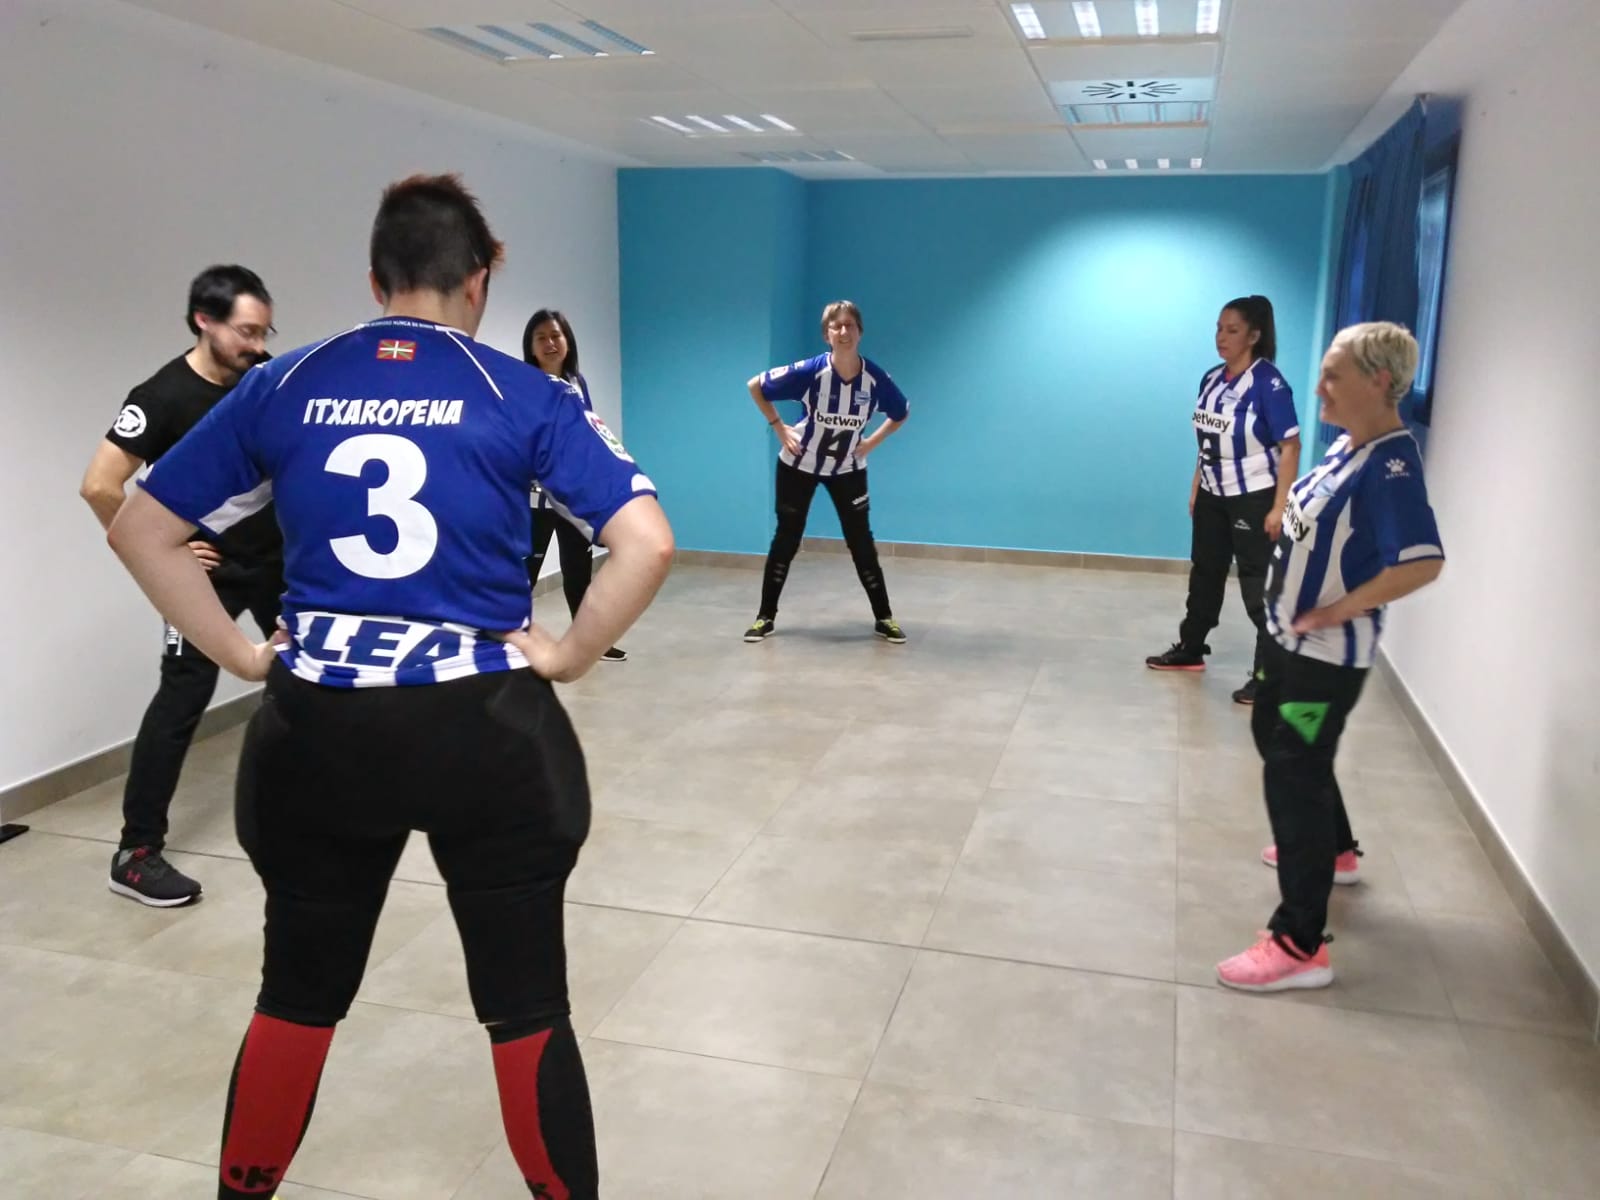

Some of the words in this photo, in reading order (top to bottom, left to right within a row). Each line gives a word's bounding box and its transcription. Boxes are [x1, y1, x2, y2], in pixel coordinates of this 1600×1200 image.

[303, 399, 463, 427] ITXAROPENA
[816, 411, 864, 430] betway
[324, 434, 438, 580] 3
[302, 615, 461, 669] LEA
